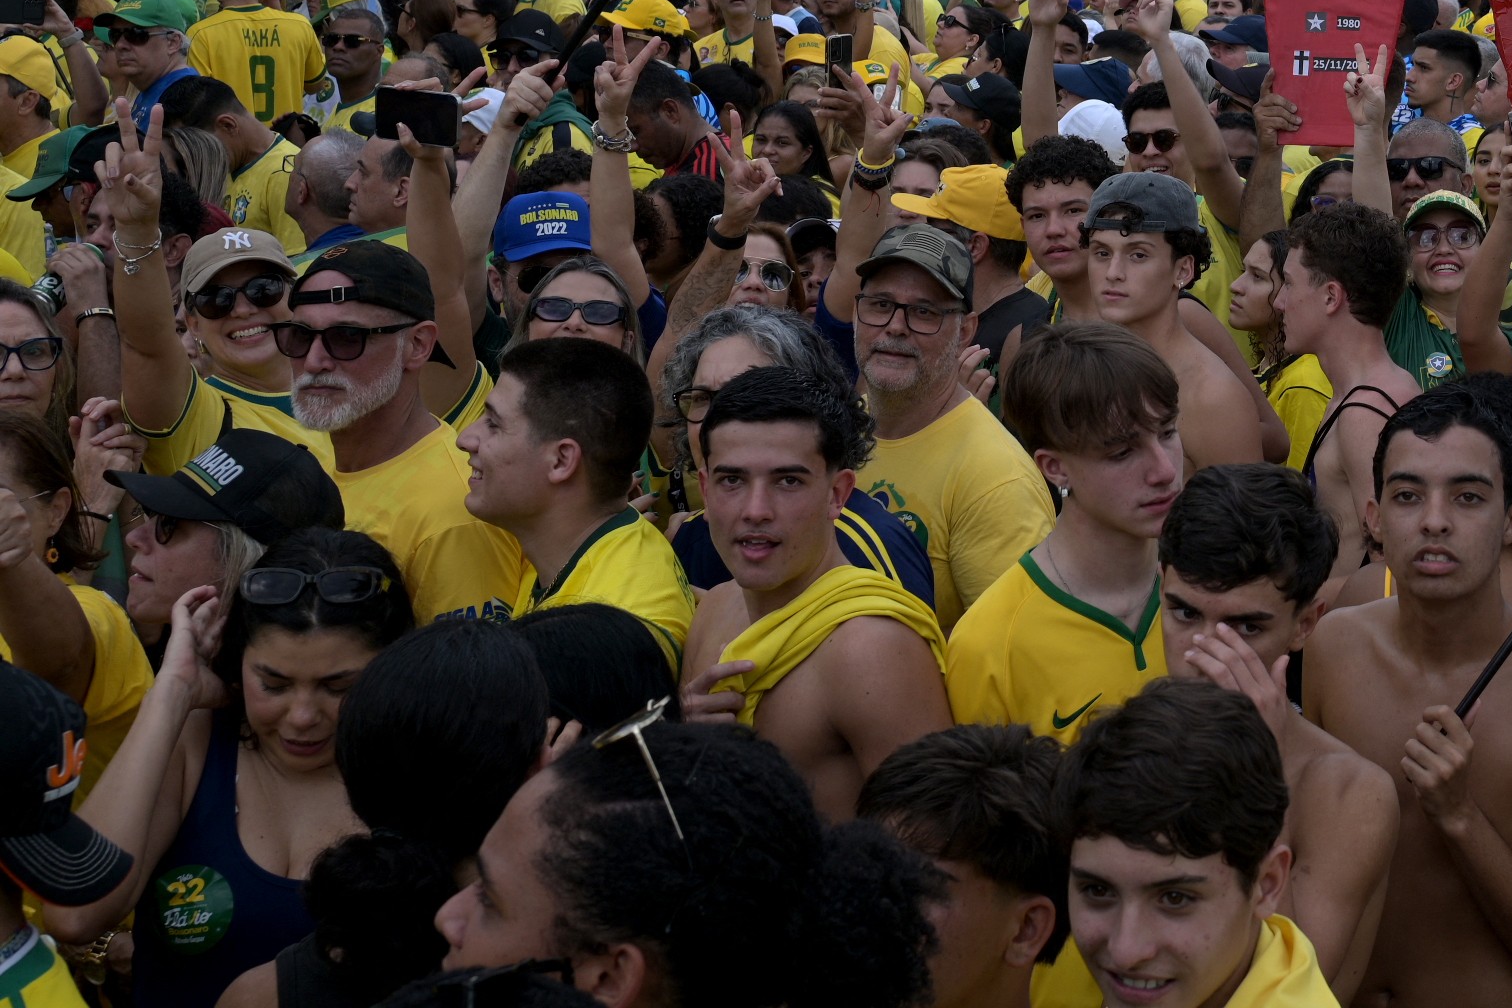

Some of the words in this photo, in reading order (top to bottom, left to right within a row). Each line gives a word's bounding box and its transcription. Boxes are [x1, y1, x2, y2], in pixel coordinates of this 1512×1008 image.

[1337, 19, 1360, 29] 1980
[1313, 58, 1370, 71] 25/11/20
[520, 209, 579, 225] BOLSONARO
[536, 222, 568, 236] 2022
[222, 231, 252, 250] NY
[166, 878, 206, 906] 22
[163, 910, 213, 929] Flávio
